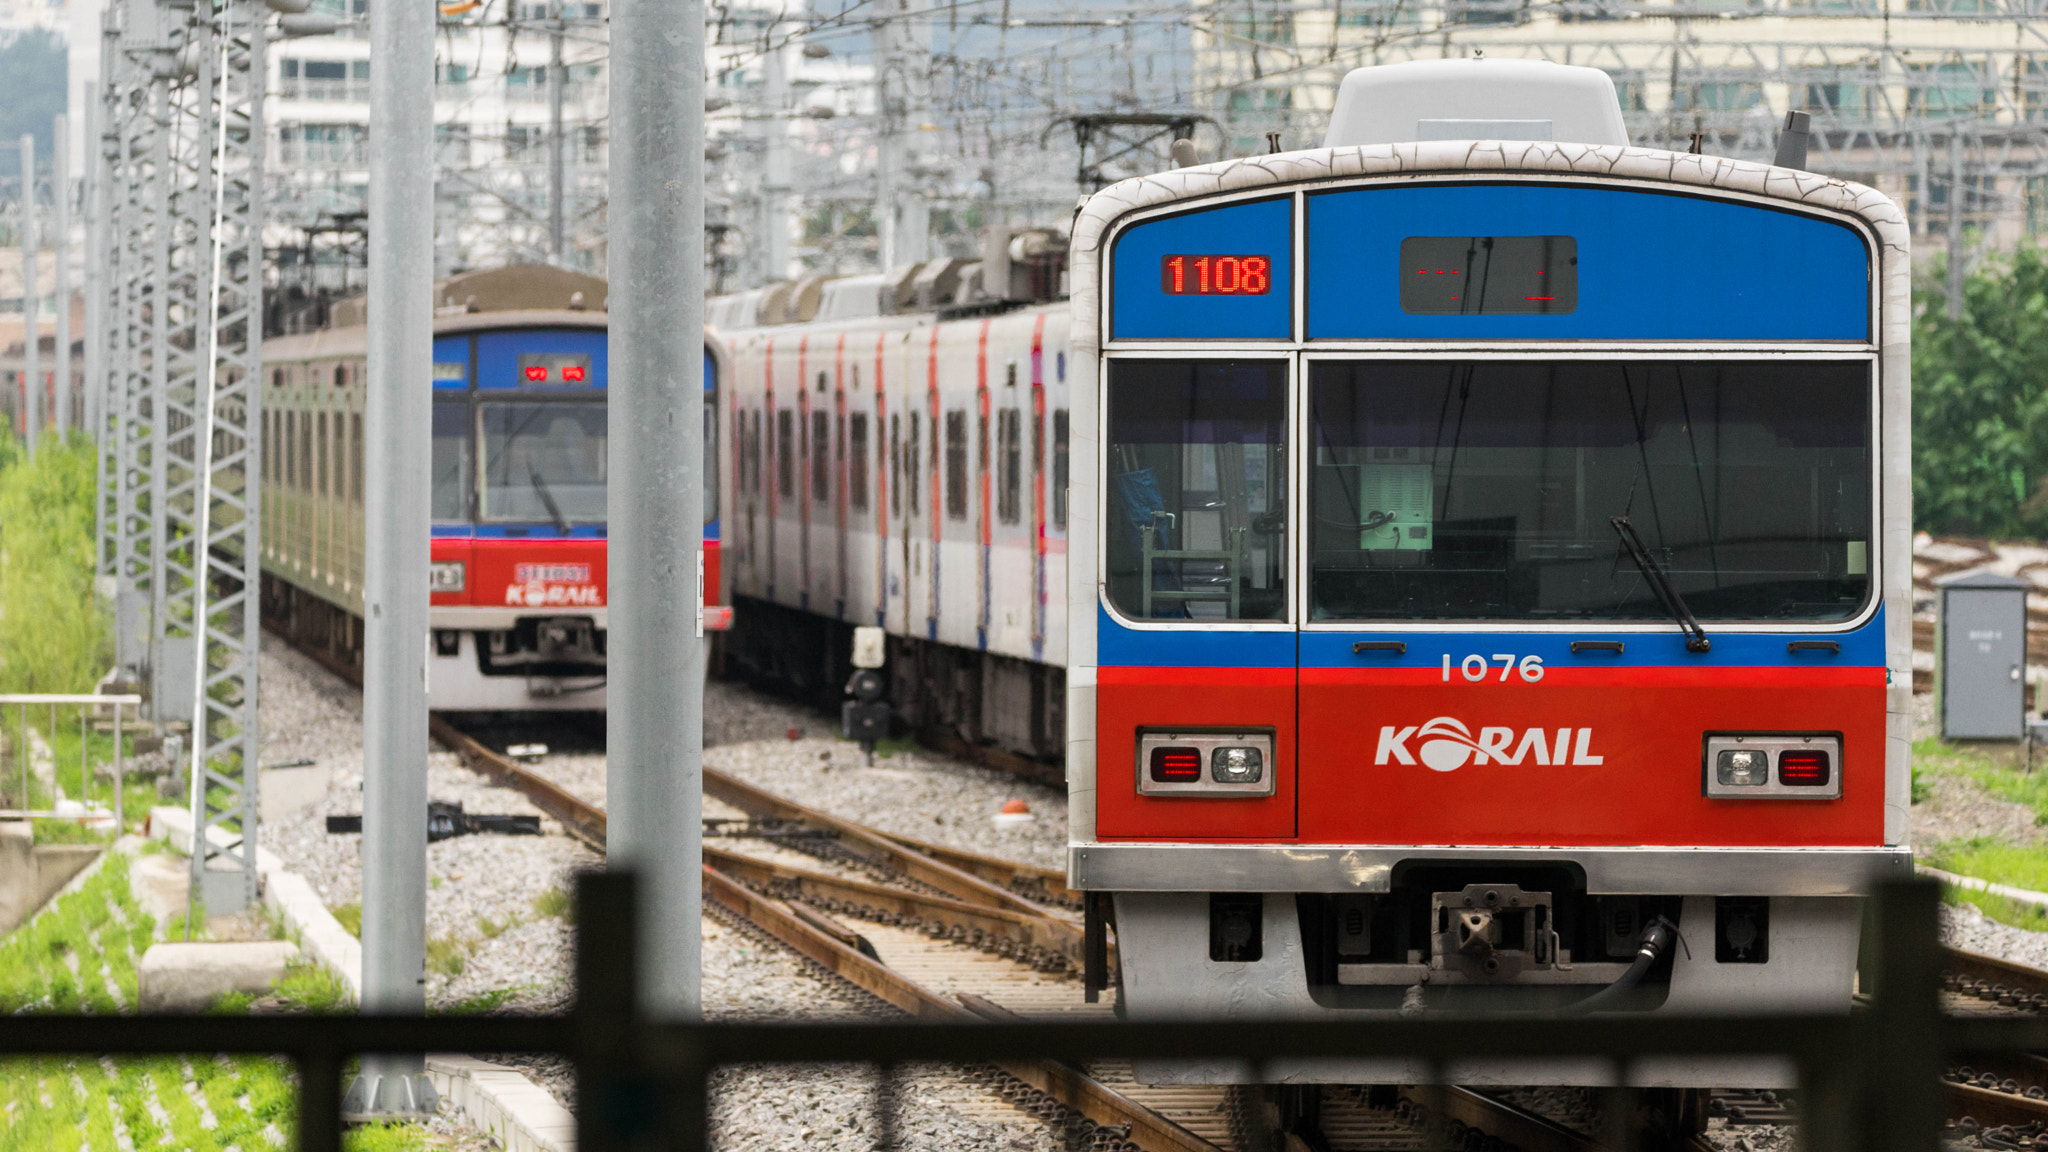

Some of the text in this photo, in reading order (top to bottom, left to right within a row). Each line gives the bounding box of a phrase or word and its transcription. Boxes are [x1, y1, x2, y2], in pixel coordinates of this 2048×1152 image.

[1168, 256, 1266, 293] 1108
[506, 582, 601, 606] KORAIL
[1442, 653, 1545, 683] 1076
[1374, 716, 1604, 772] KORAIL
